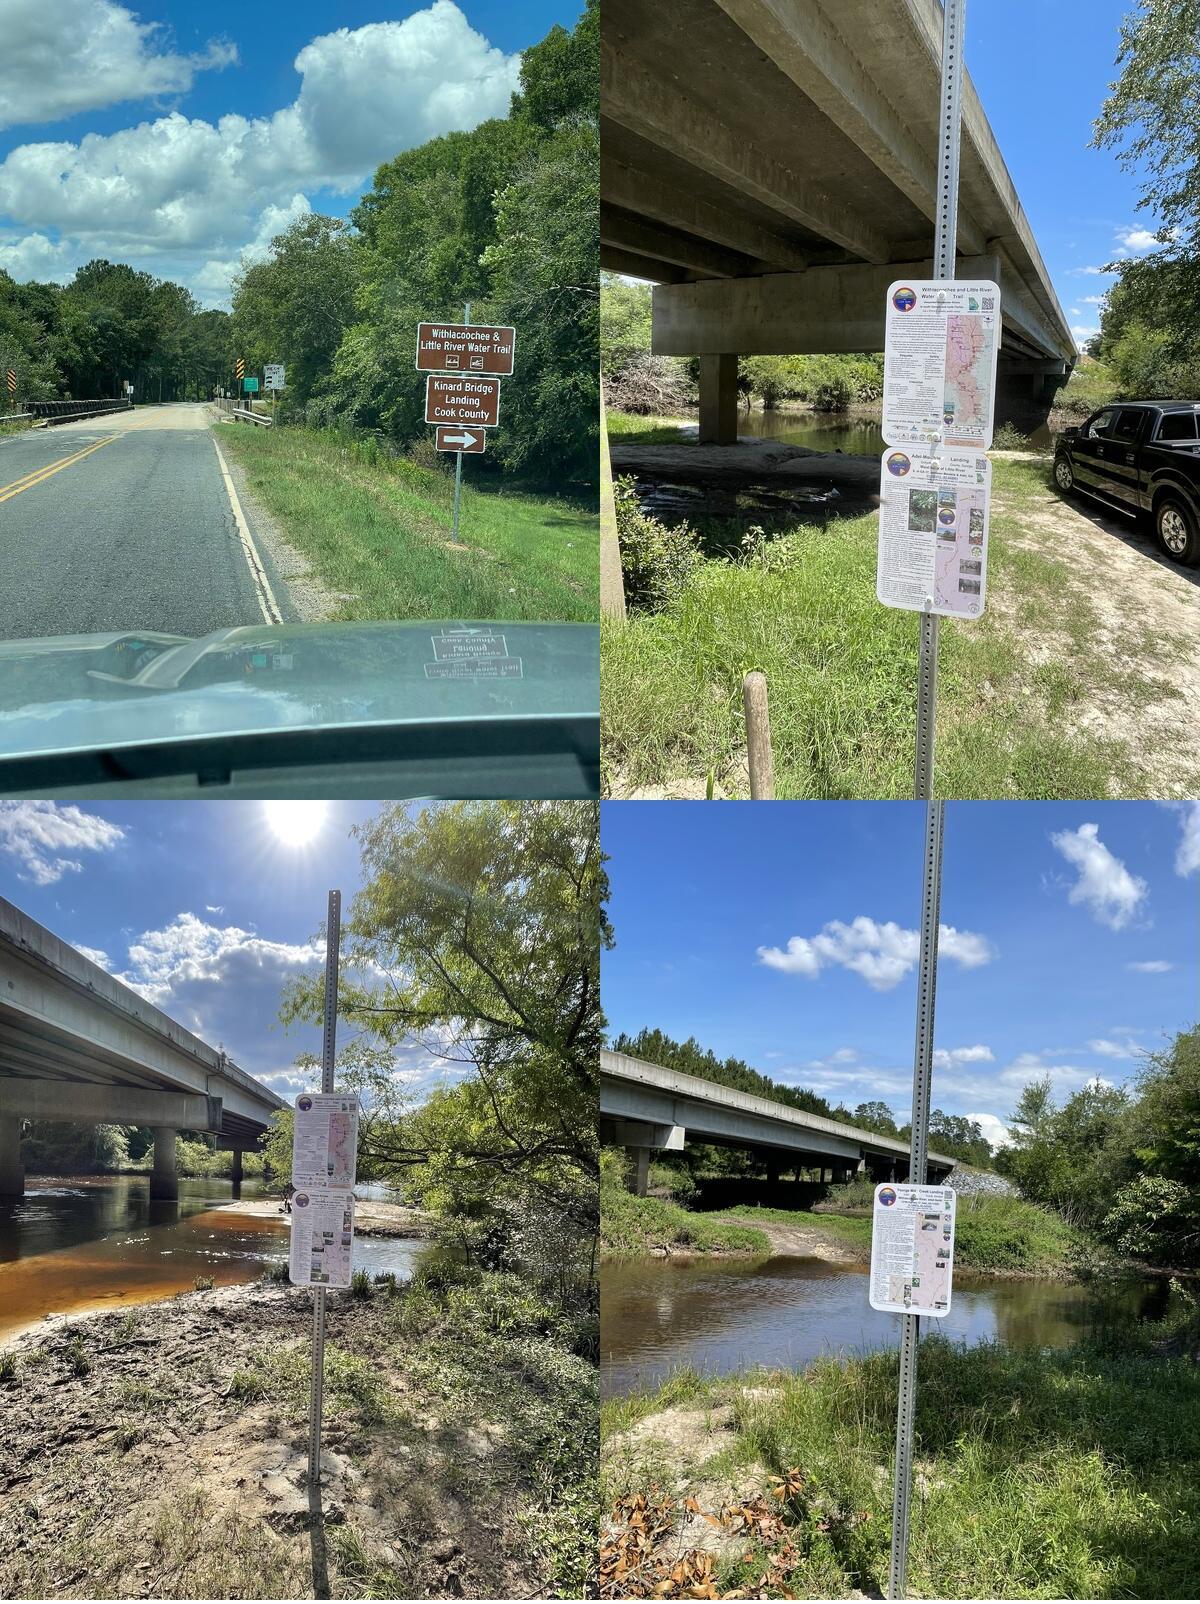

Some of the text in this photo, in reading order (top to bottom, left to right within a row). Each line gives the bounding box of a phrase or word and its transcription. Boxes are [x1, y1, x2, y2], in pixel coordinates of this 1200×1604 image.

[432, 329, 500, 341] Withlacoochee &
[421, 341, 511, 354] Little River Water Trail
[434, 381, 493, 396] Kinard Bridge
[445, 395, 480, 408] Landing
[434, 407, 490, 421] Cook County
